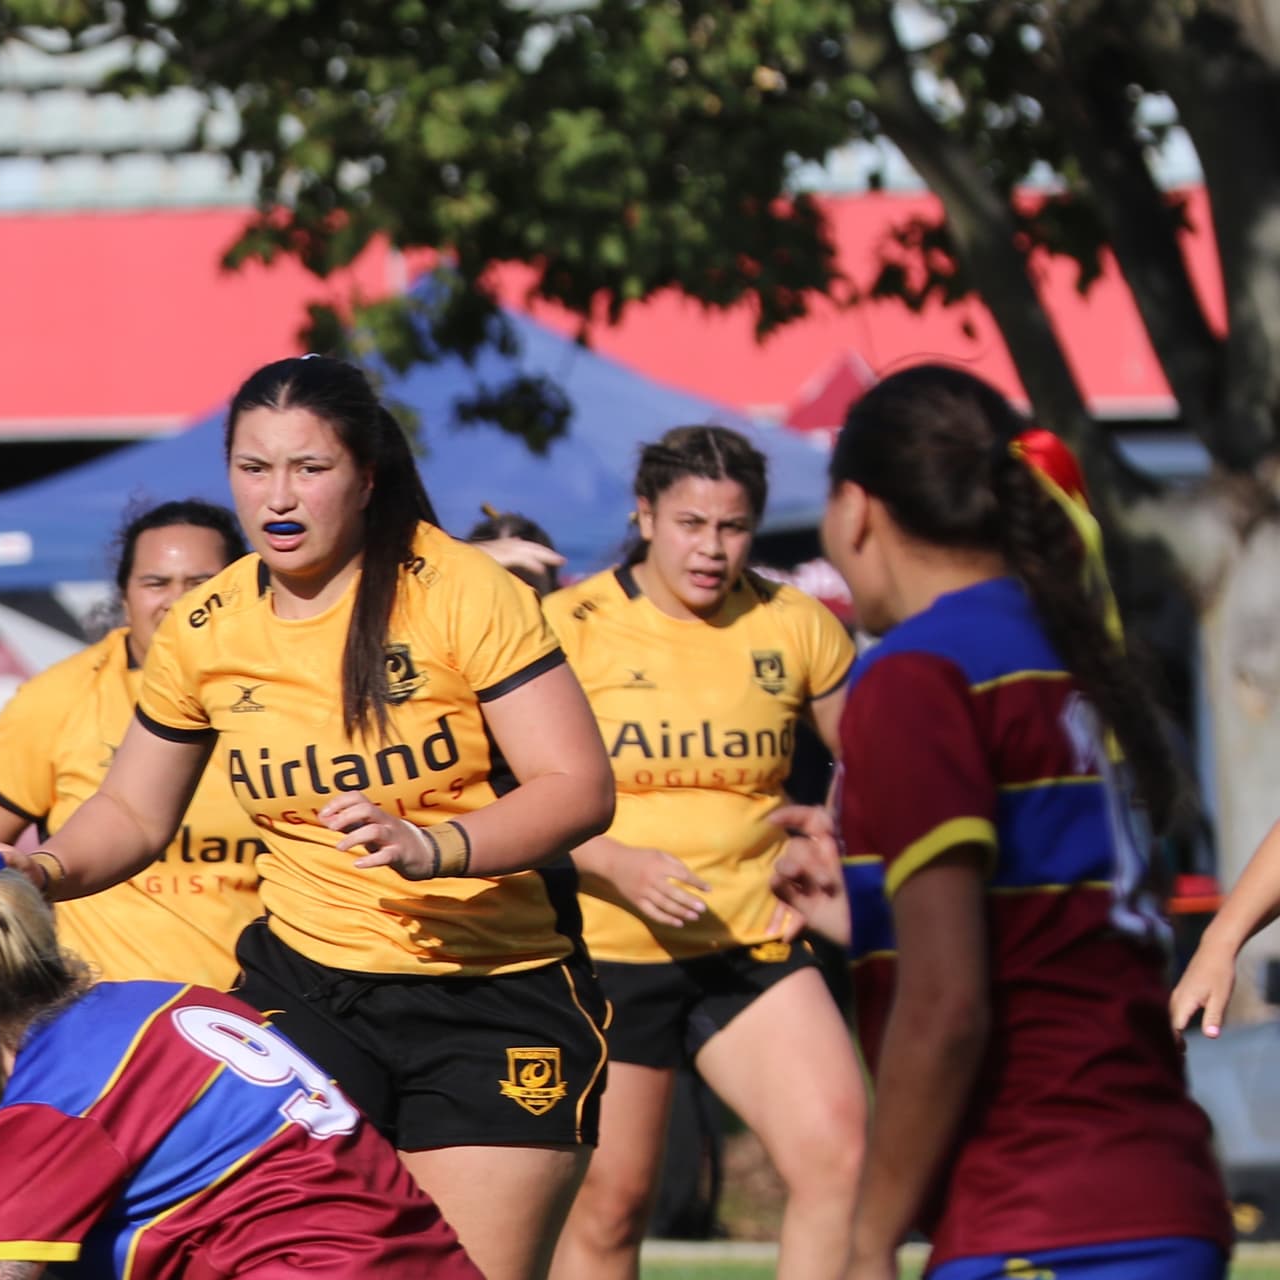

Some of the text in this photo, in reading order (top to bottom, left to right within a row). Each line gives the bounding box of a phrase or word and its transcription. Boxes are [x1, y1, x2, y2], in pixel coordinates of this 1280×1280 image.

[230, 715, 460, 800] Airland
[610, 719, 793, 758] Airland
[171, 1006, 360, 1140] 9
